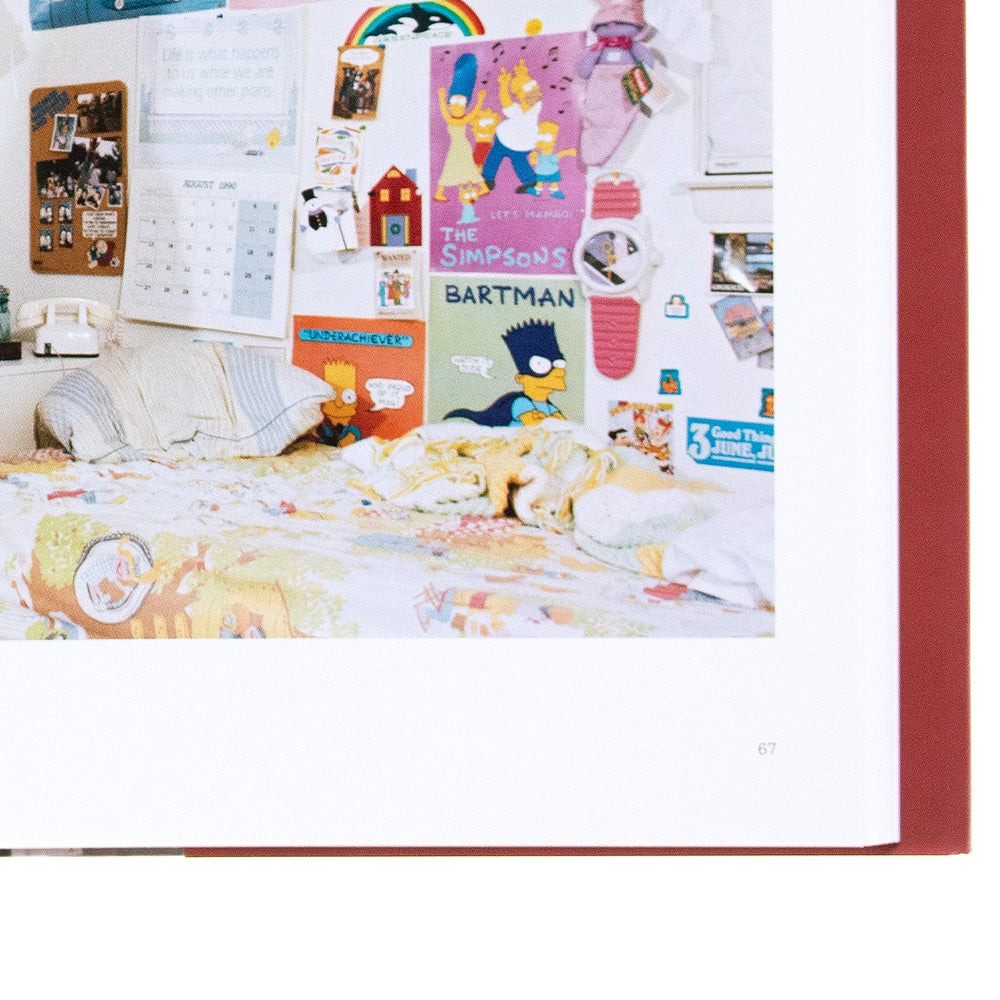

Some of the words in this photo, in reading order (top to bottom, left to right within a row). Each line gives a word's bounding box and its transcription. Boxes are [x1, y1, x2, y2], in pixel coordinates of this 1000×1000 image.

[183, 180, 215, 189] AUGUST
[219, 181, 237, 190] 1990
[490, 210, 518, 220] LET'S
[440, 226, 478, 243] THE
[440, 243, 567, 269] SIMPSONS
[445, 284, 575, 308] BARTMAN
[689, 422, 711, 461] 3
[710, 425, 742, 441] Good
[758, 742, 776, 756] 67
